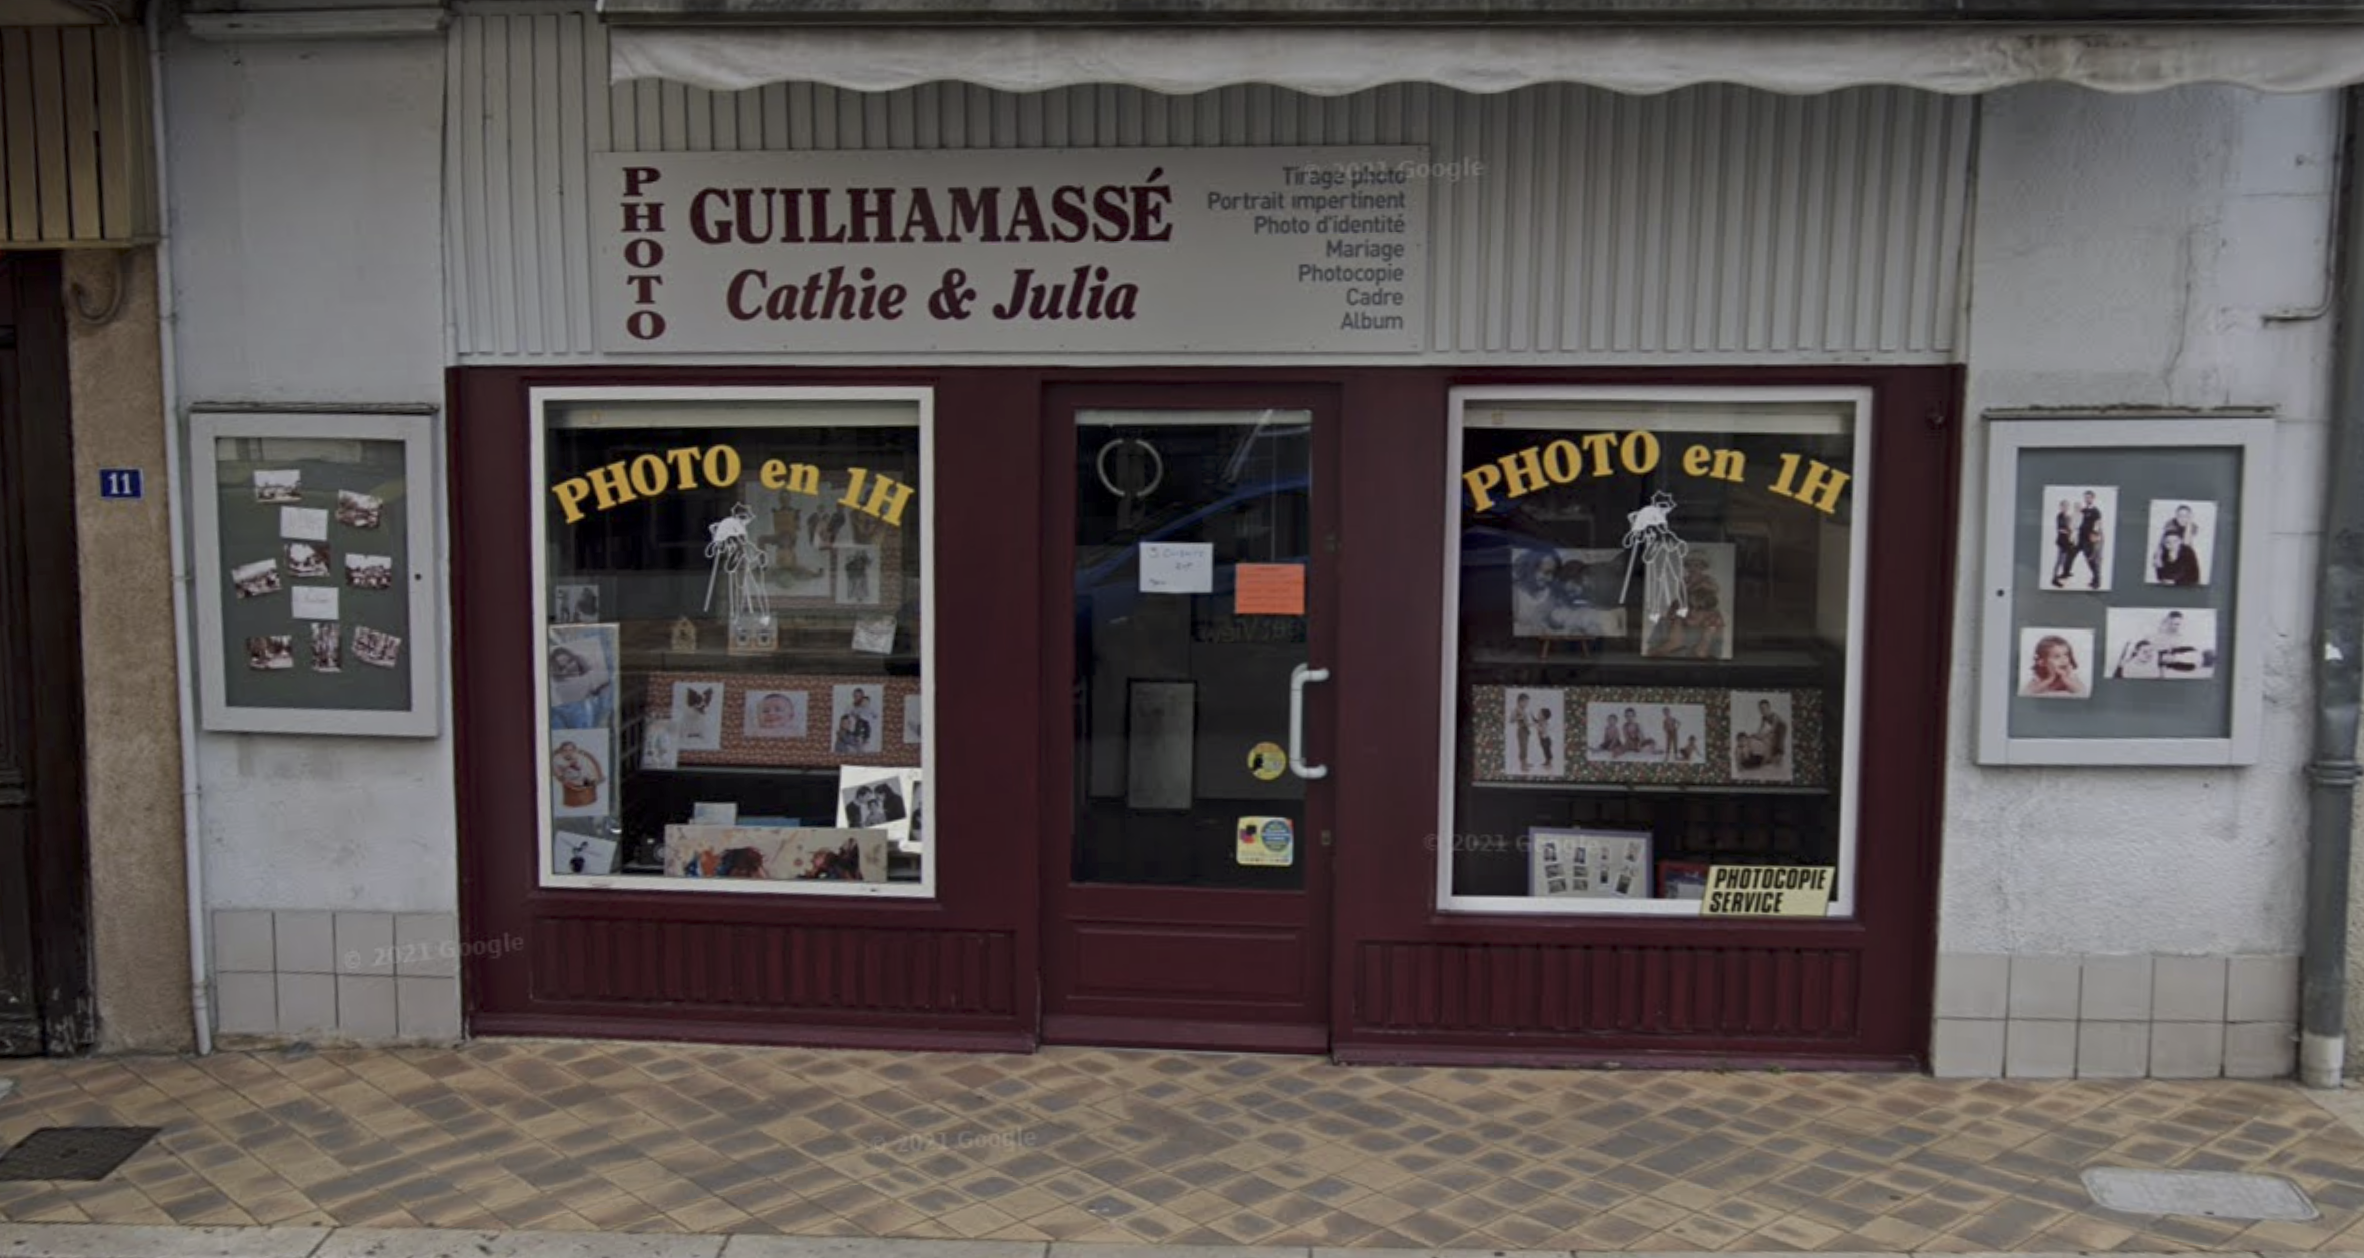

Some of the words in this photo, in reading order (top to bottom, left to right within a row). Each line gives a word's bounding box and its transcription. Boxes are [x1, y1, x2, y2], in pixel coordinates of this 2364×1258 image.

[1283, 166, 1345, 190] Tirage
[1351, 166, 1407, 189] photo
[689, 166, 1174, 246] GUILHAMASSÉ
[1207, 191, 1284, 211] Portrait
[1291, 191, 1406, 214] impertinent
[1254, 215, 1311, 234] Photo
[1316, 212, 1406, 234] d'identité
[620, 166, 667, 340] PHOTO
[1325, 239, 1405, 262] Mariage
[1298, 263, 1404, 285] Photocopie
[726, 265, 908, 321] Cathie
[928, 267, 978, 320] &
[992, 264, 1140, 320] Julia
[1345, 287, 1404, 306] Cadre
[1339, 311, 1404, 331] Album
[108, 472, 132, 495] 11
[1462, 430, 1661, 513] PHOTO
[1682, 444, 1747, 483] en
[1769, 451, 1851, 515] 1H
[552, 444, 742, 525] PHOTO
[759, 457, 821, 496] en
[837, 466, 915, 527] 1H
[1714, 868, 1827, 890] PHOTOCOPIE
[1709, 891, 1784, 913] SERVICE
